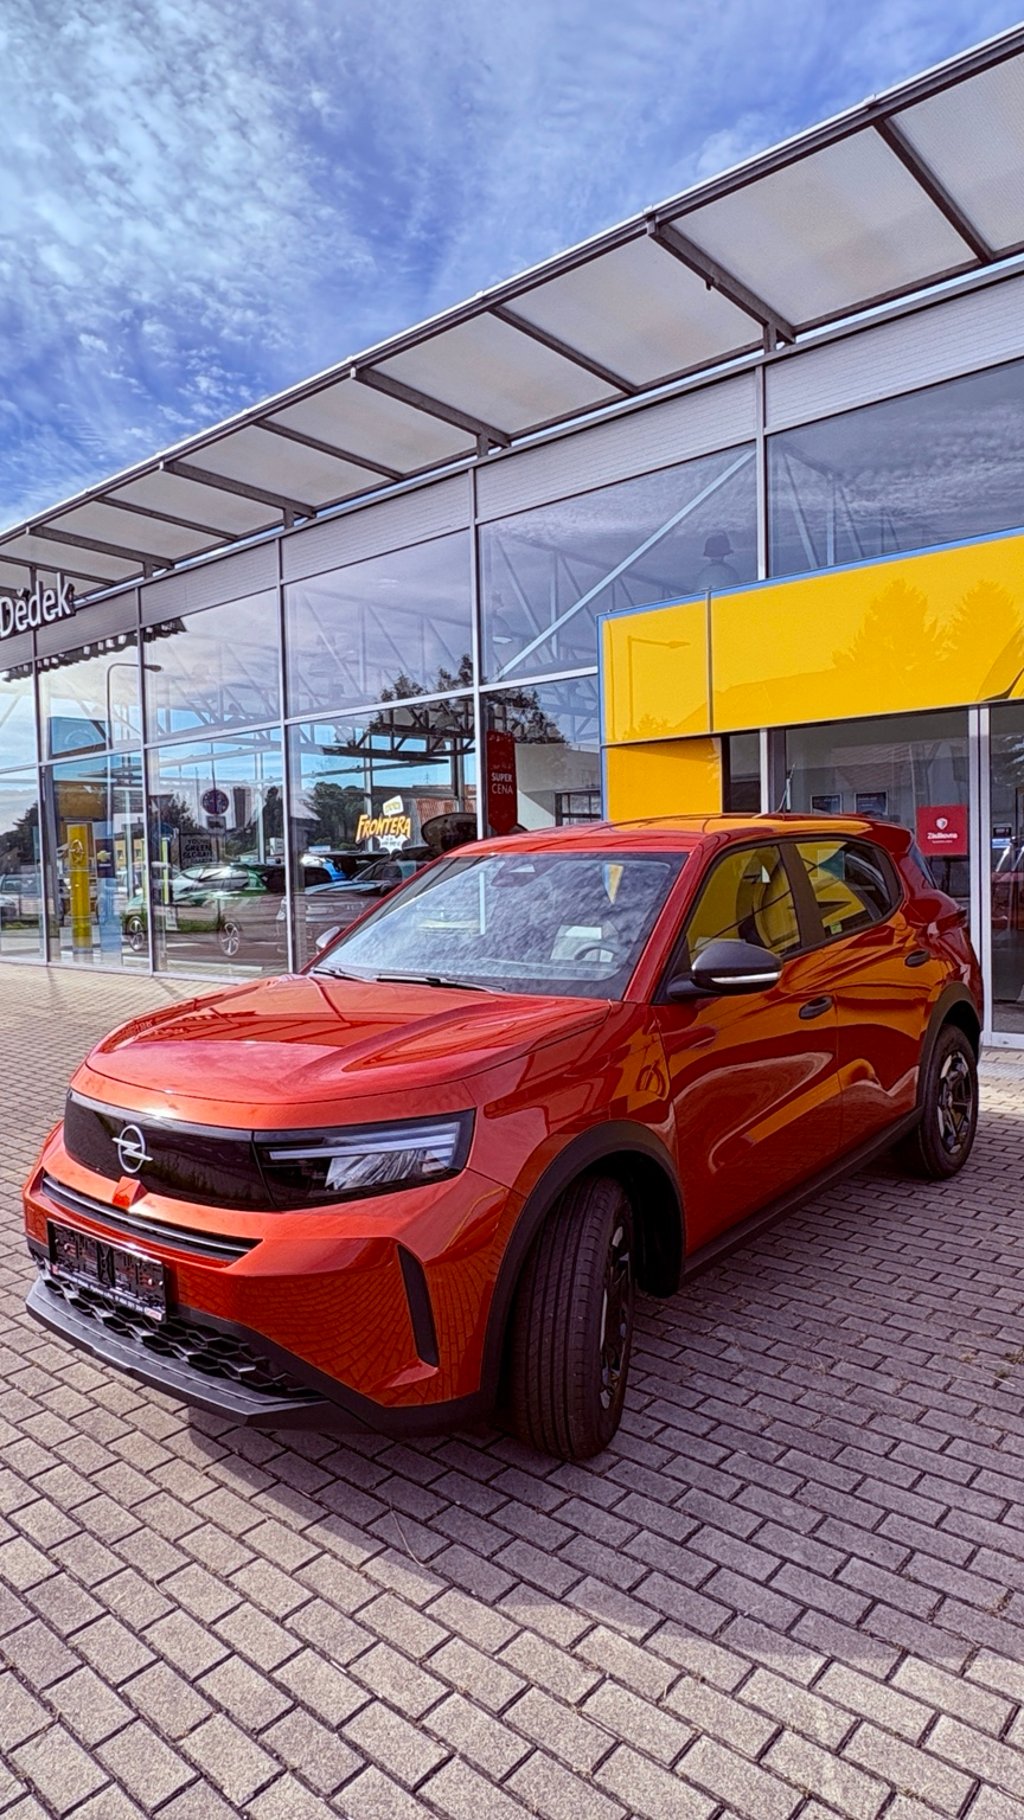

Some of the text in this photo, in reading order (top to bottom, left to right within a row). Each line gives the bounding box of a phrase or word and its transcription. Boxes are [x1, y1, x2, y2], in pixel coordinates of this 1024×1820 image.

[0, 572, 71, 638] Dědek
[491, 772, 513, 782] SUPER
[491, 783, 514, 795] CENA
[355, 814, 411, 844] FRONTERA
